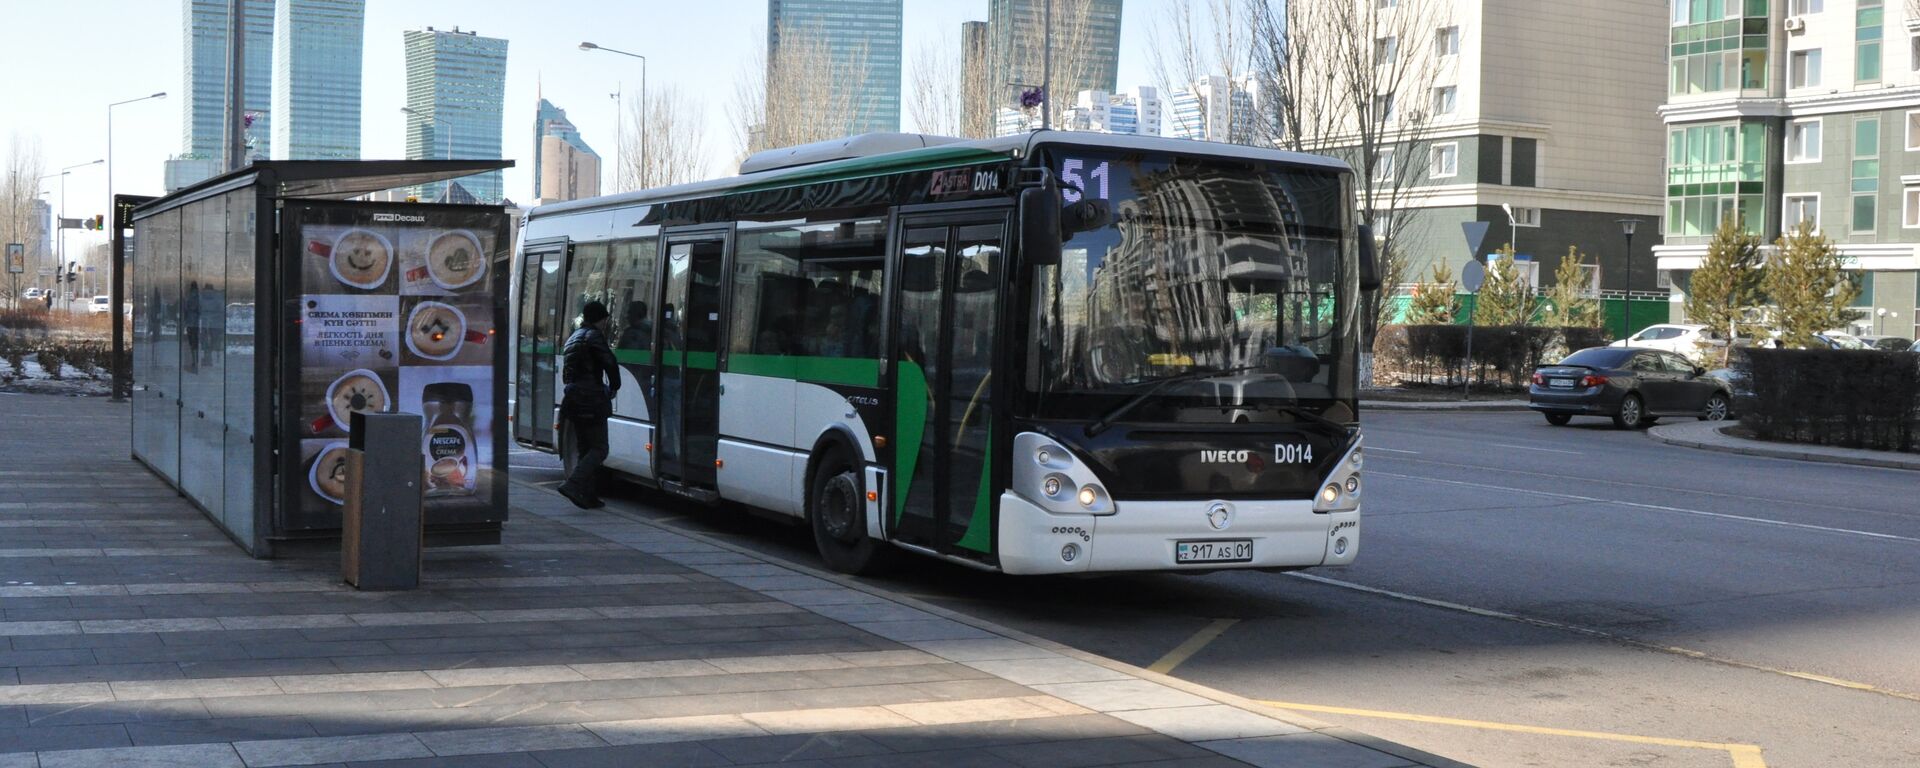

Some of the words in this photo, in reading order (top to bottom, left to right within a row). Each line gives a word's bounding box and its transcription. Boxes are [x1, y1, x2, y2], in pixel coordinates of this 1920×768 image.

[973, 171, 999, 192] D014
[1062, 158, 1109, 202] 51
[1201, 450, 1249, 463] IVECO
[1274, 443, 1313, 464] D014
[1191, 544, 1213, 559] 917
[1217, 546, 1231, 558] AS
[1236, 543, 1250, 558] 01
